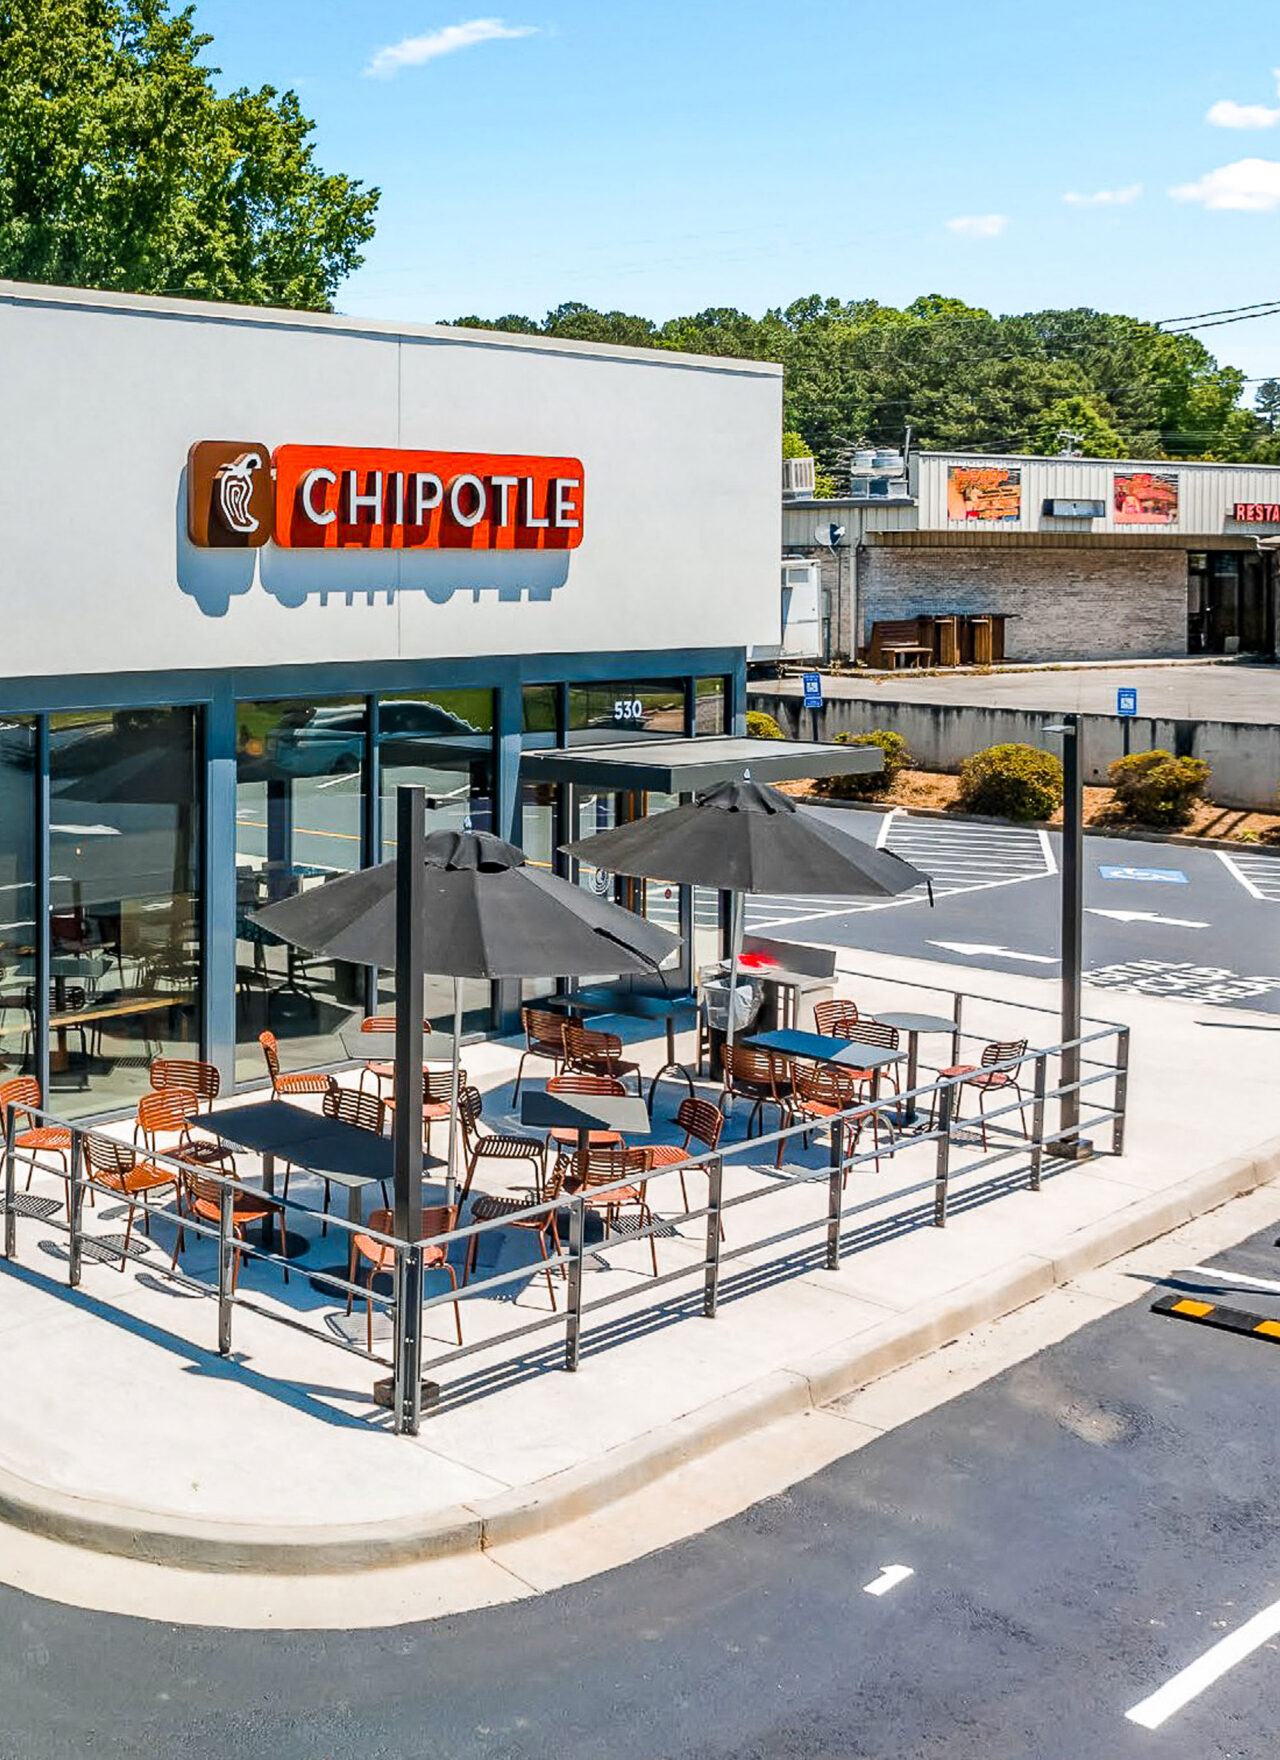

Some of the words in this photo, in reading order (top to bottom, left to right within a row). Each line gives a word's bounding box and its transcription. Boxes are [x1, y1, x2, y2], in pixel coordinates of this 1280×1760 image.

[302, 467, 580, 528] CHIPOTLE
[1236, 503, 1280, 521] RESTA
[614, 700, 643, 720] 530
